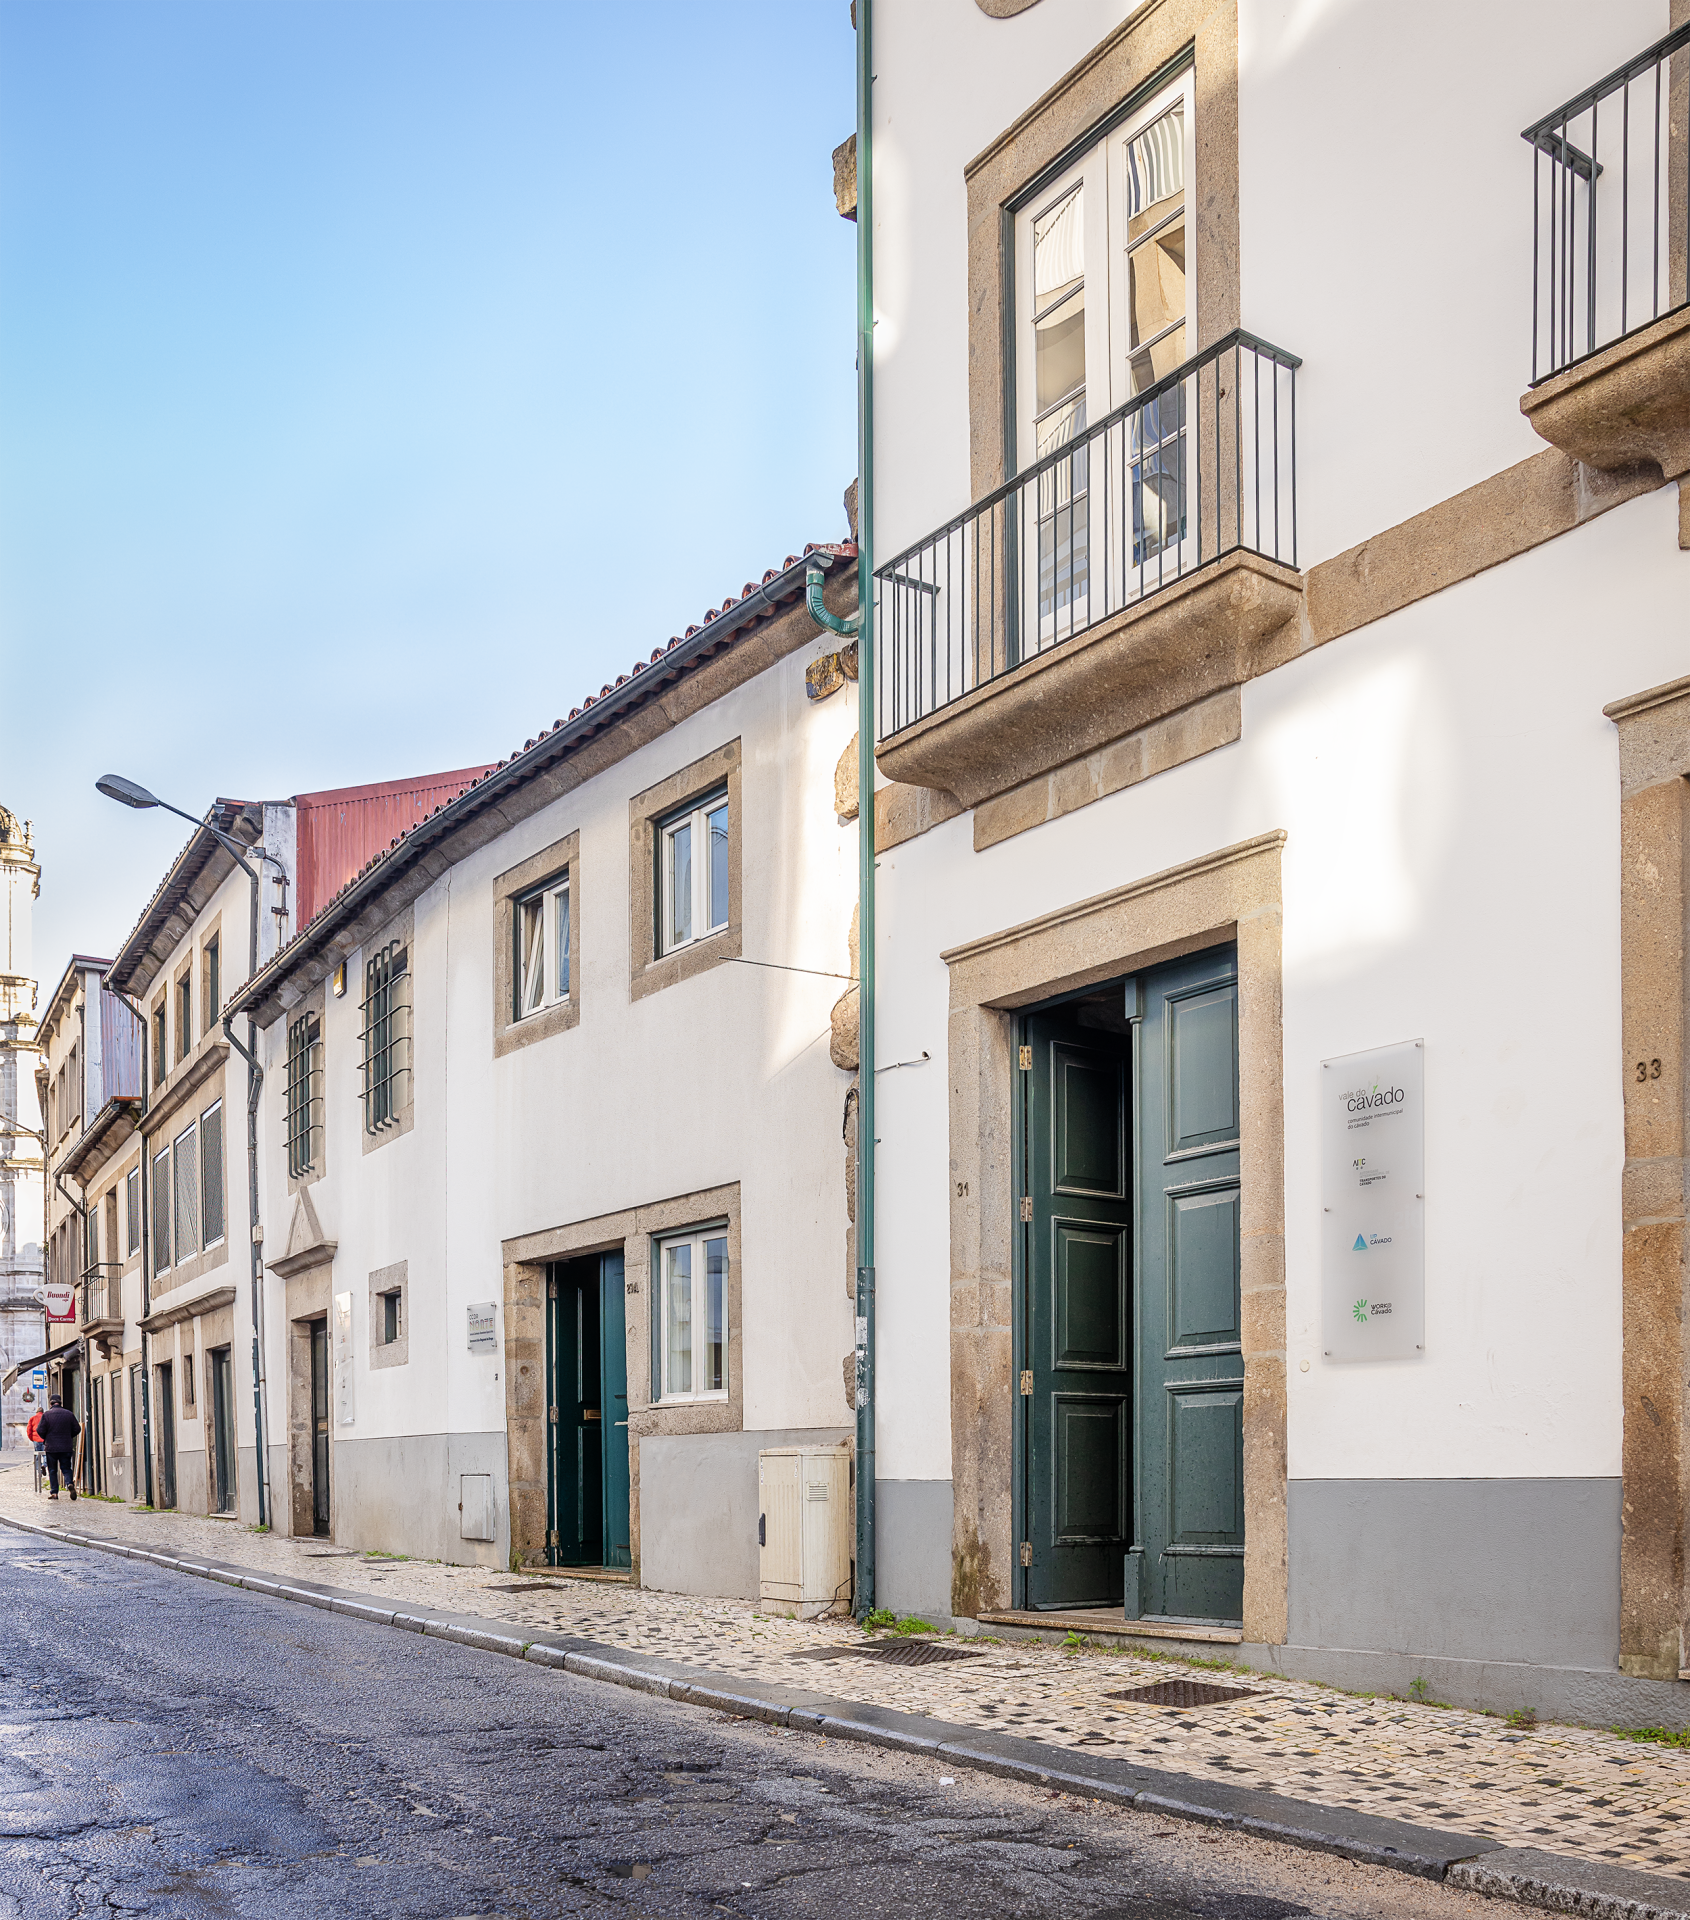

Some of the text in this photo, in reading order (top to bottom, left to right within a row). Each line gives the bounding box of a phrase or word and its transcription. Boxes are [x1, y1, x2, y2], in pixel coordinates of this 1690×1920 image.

[1636, 1058, 1662, 1083] 33
[1338, 1089, 1366, 1101] vale do
[957, 1182, 969, 1197] 31
